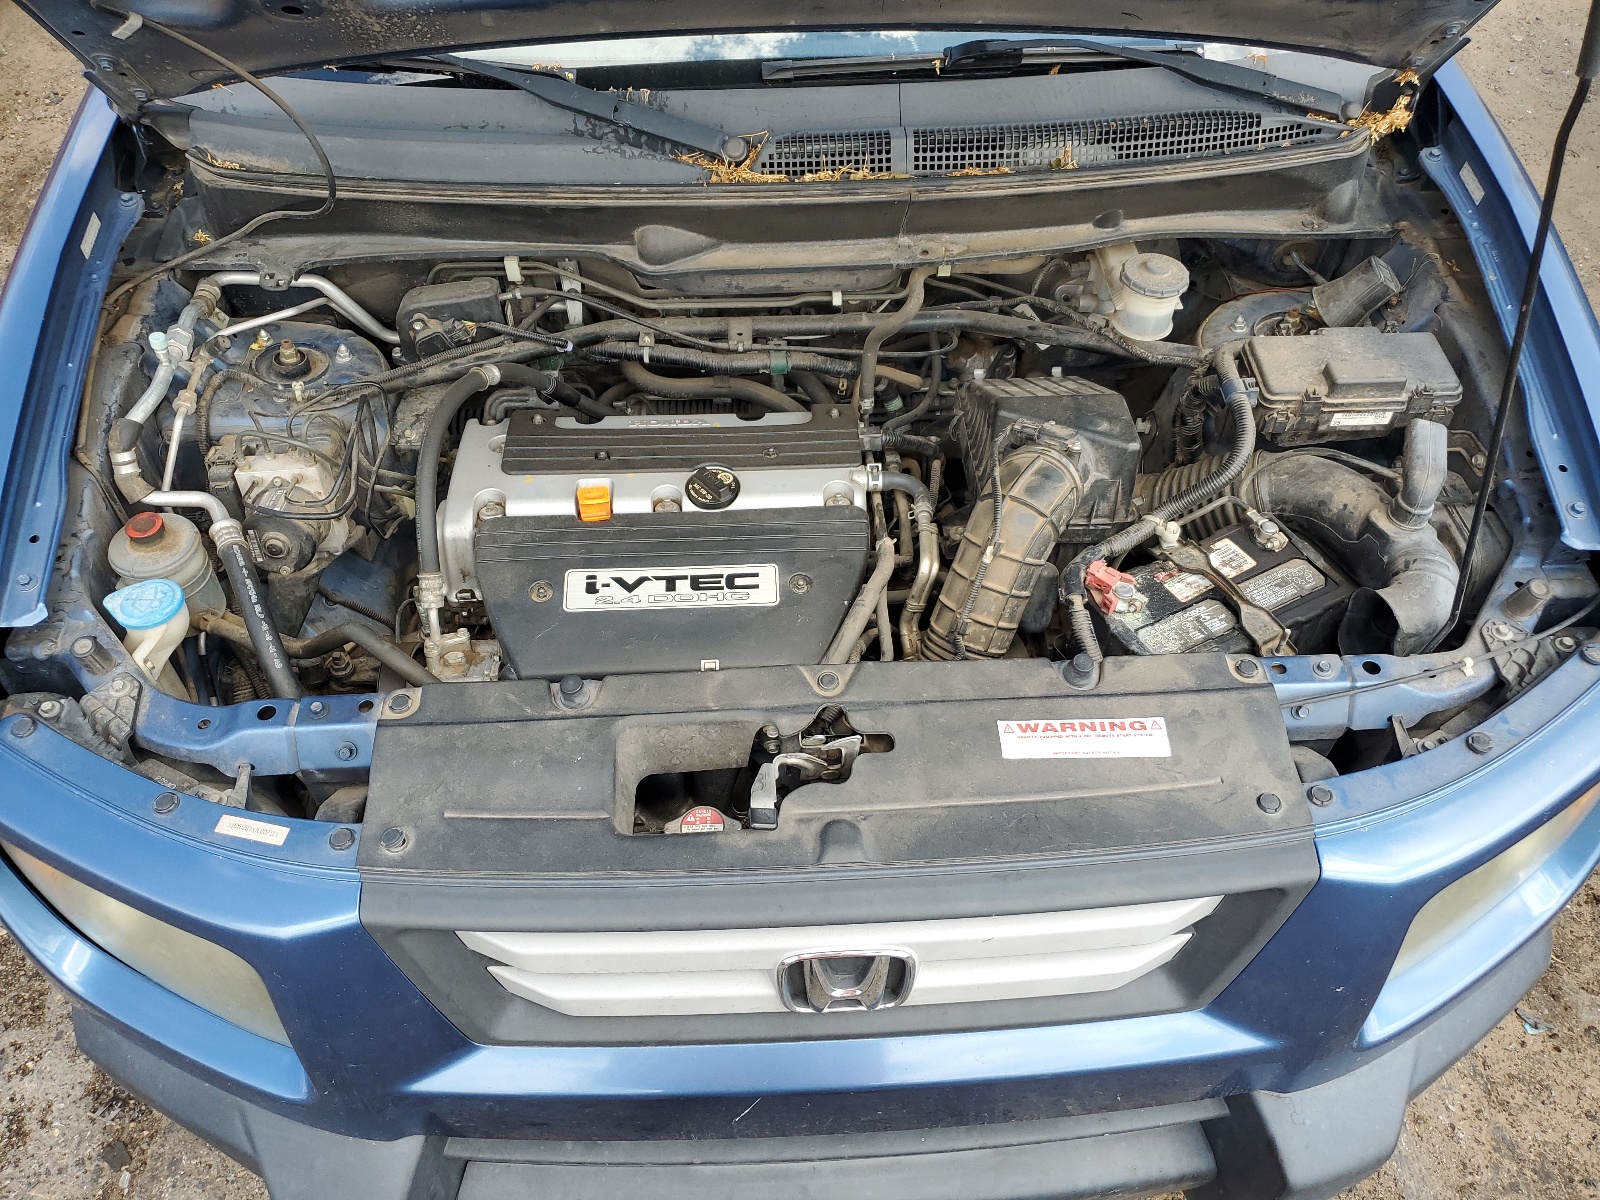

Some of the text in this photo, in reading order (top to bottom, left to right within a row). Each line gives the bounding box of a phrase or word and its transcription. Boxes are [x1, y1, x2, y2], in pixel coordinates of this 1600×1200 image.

[628, 419, 711, 427] HONDA
[585, 572, 760, 594] i-VTEC
[594, 595, 641, 605] 2.4
[1016, 720, 1147, 733] WARNING
